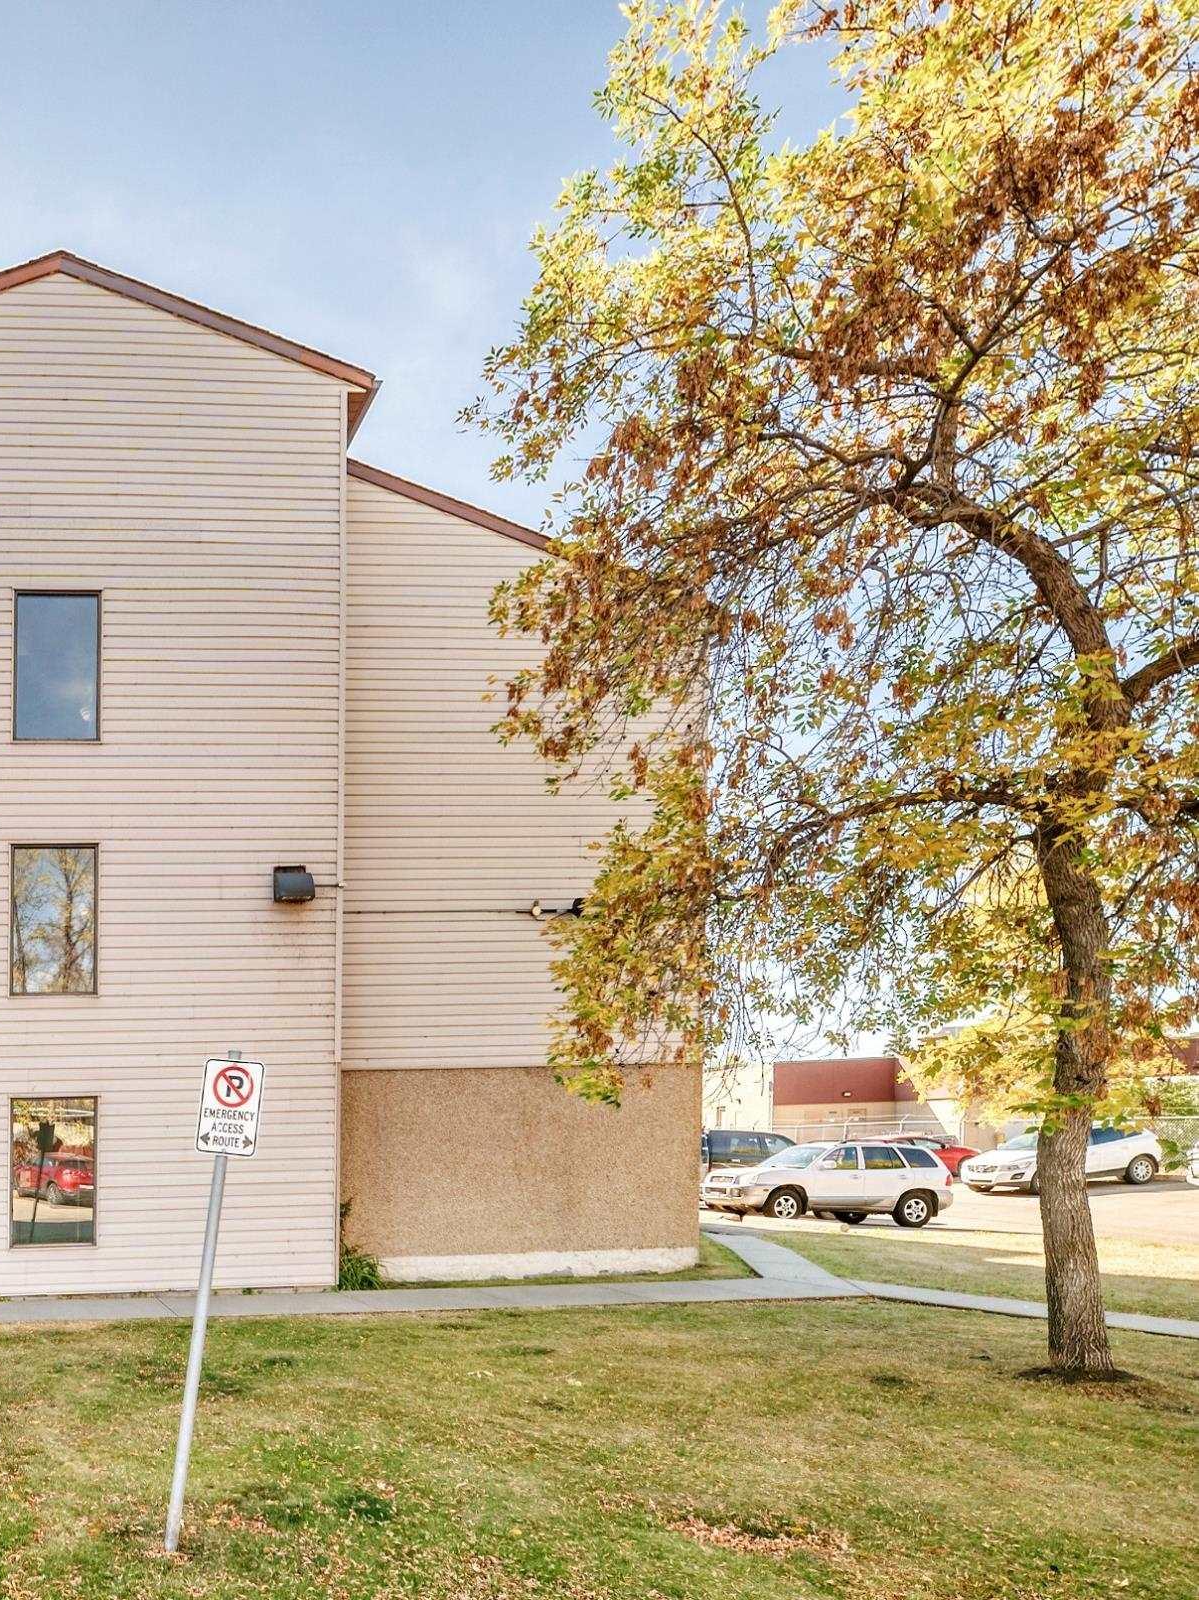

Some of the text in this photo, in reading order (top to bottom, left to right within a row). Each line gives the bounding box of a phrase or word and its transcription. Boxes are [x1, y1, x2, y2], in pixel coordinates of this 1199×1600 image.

[203, 1108, 255, 1121] EMERGENCY
[211, 1122, 244, 1134] ACCESS
[212, 1135, 240, 1148] ROUTE
